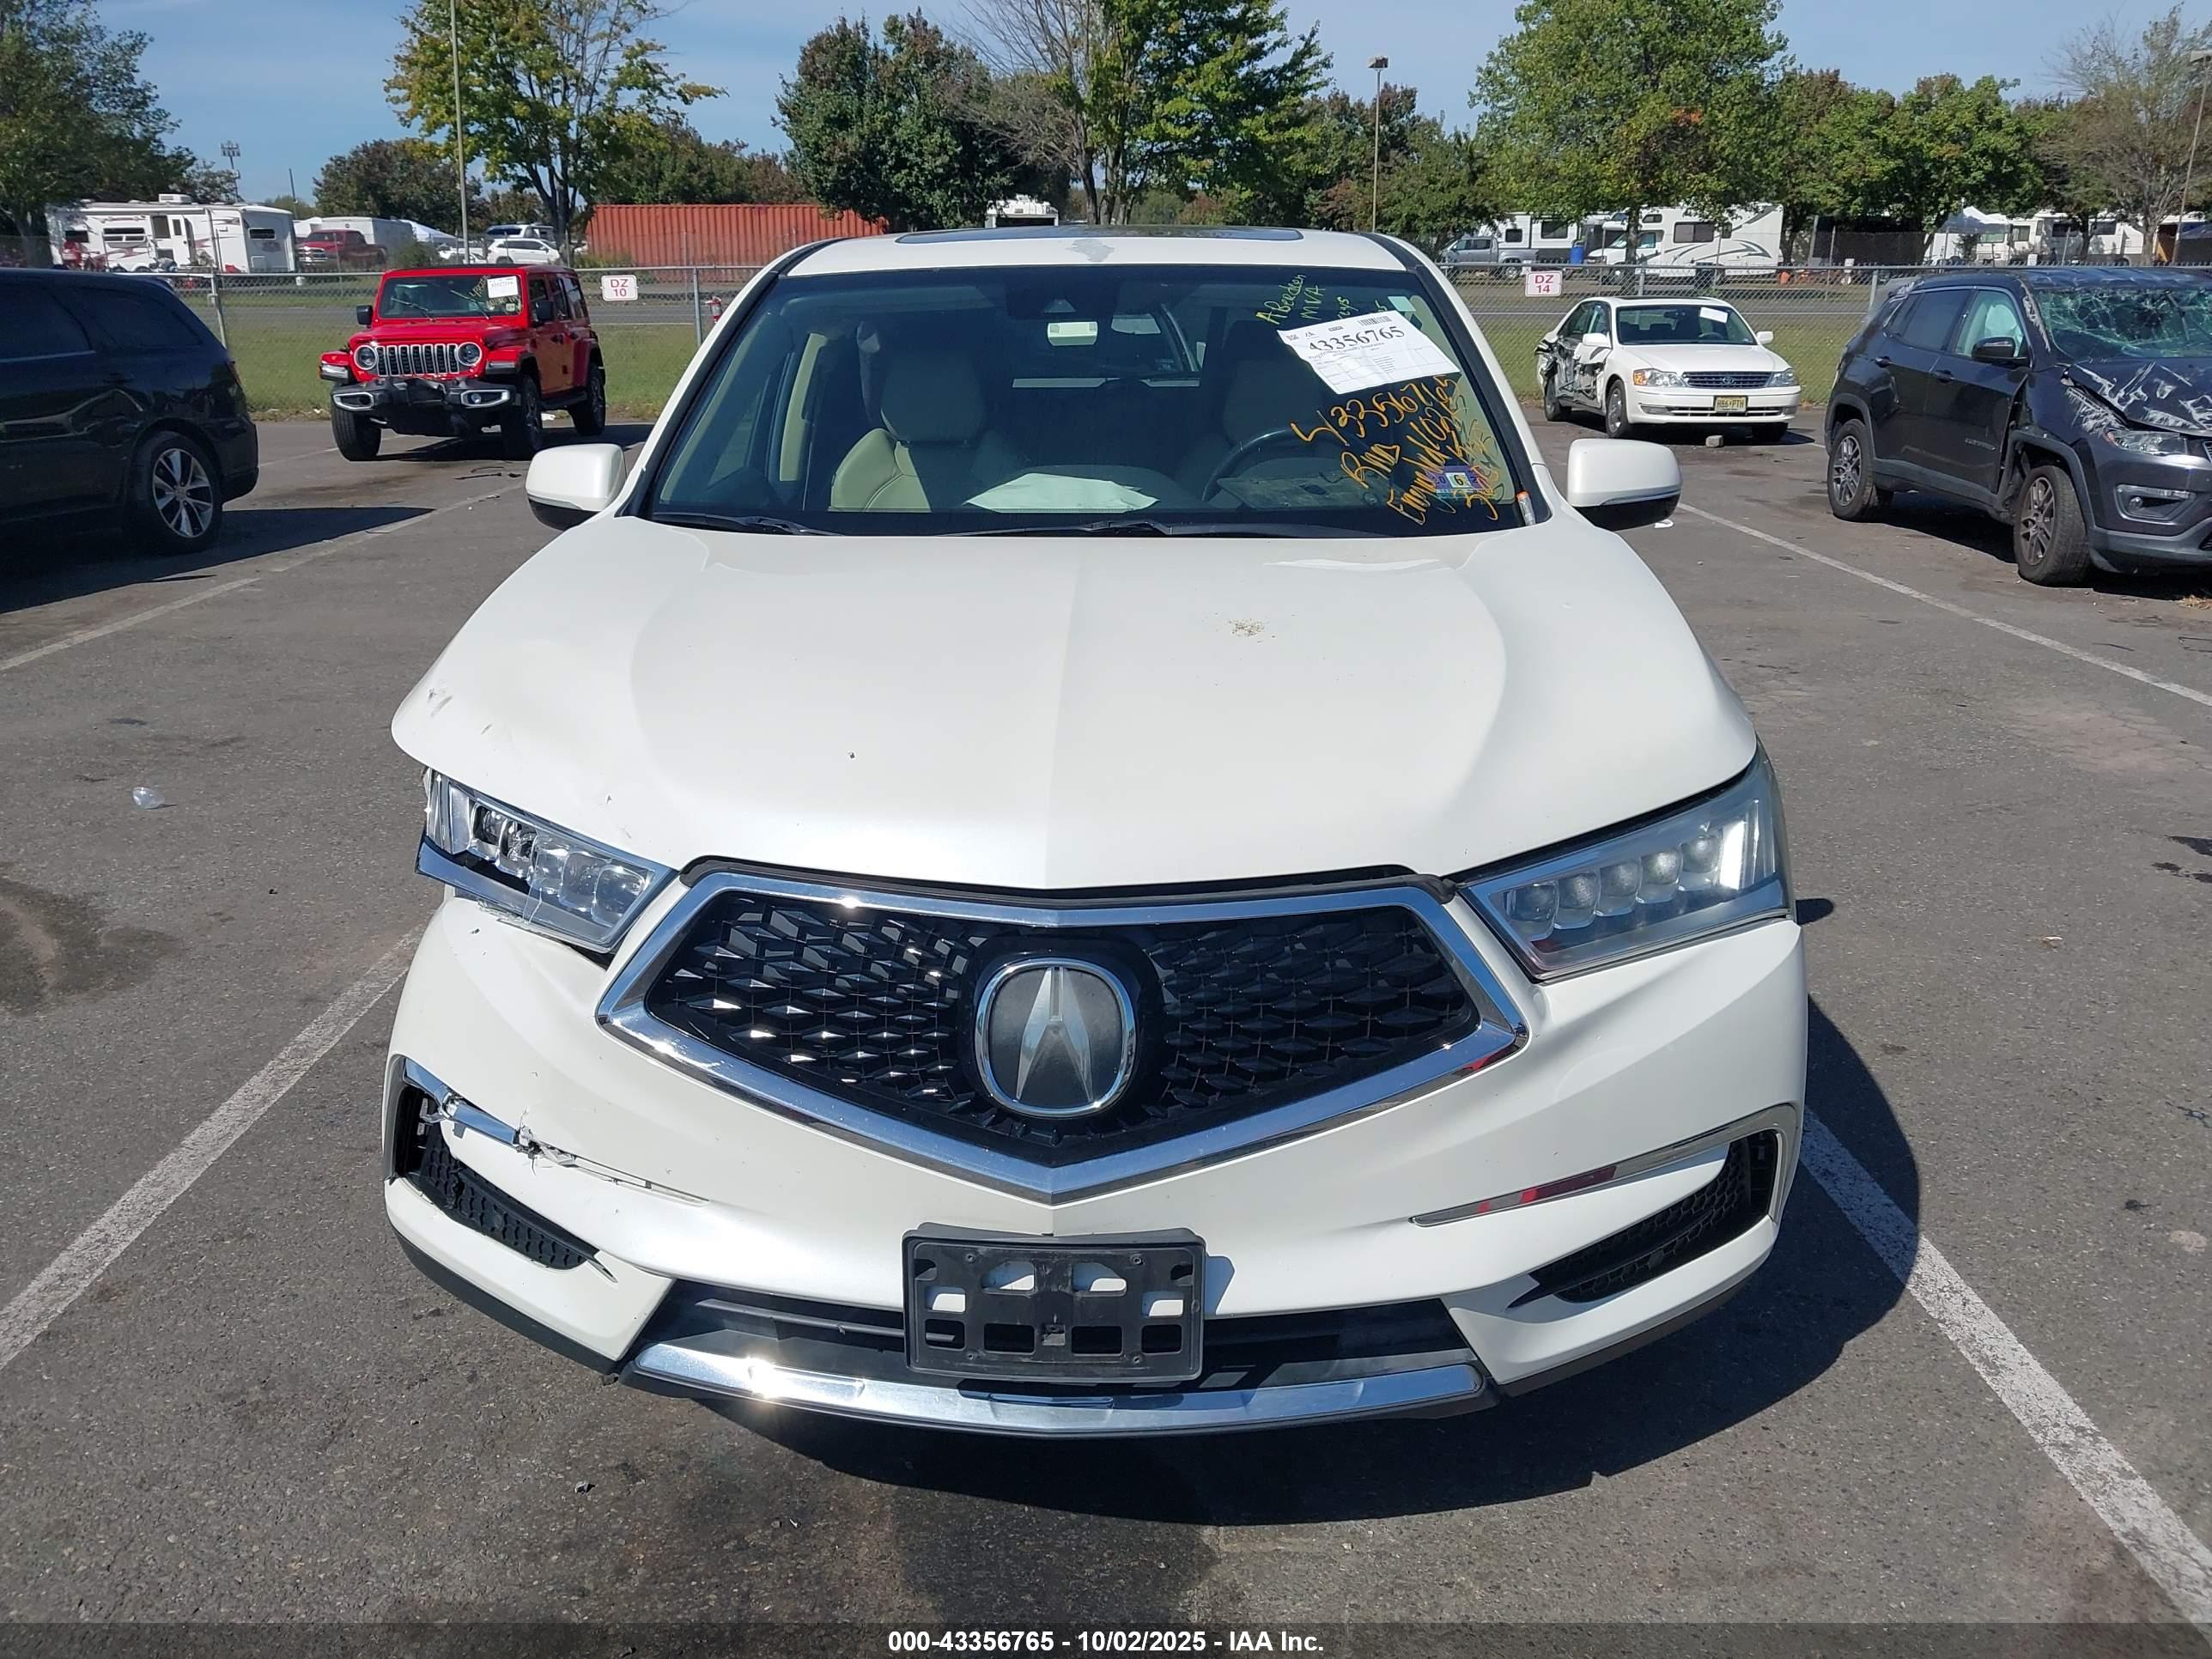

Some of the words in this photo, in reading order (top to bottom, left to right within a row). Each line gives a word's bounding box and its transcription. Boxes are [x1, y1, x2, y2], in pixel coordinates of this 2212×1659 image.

[1535, 275, 1554, 283] DZ
[611, 279, 629, 288] DZ
[613, 289, 627, 297] 10
[1310, 325, 1405, 351] 43356765
